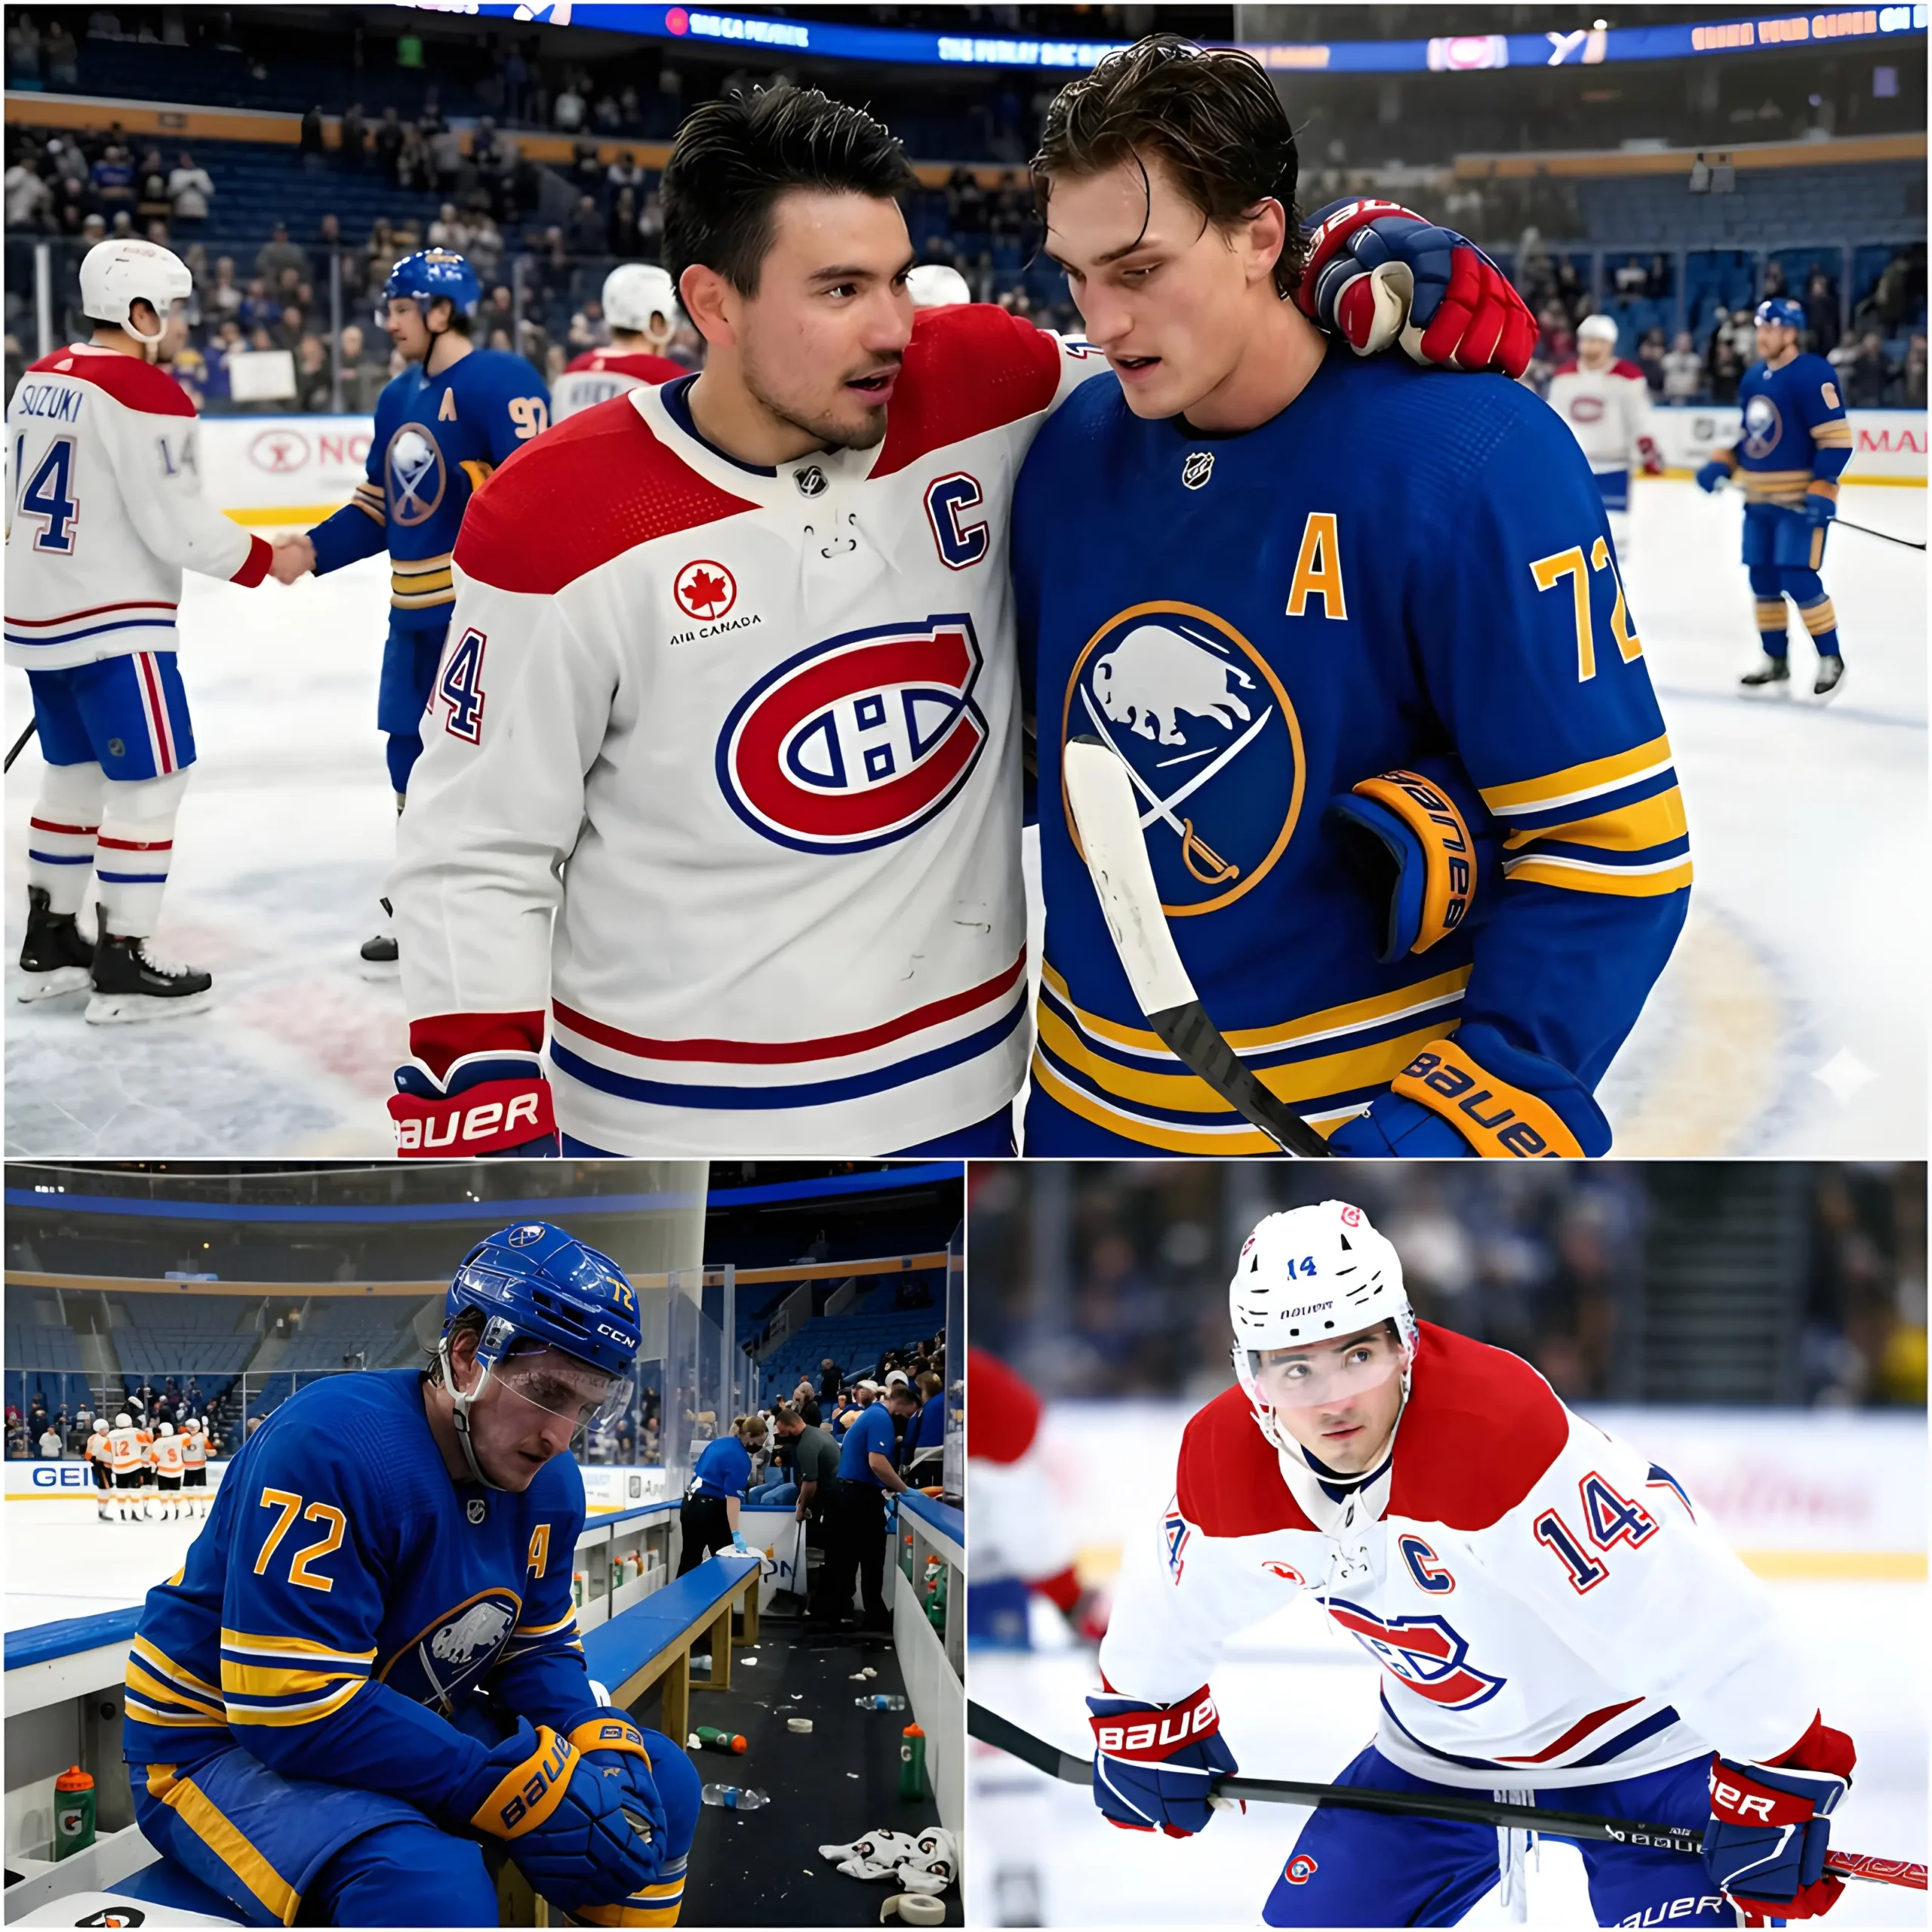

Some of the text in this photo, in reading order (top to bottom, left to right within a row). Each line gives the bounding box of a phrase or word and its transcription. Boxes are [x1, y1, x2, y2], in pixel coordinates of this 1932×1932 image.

[19, 384, 83, 423] SUZUKI
[438, 387, 457, 421] A
[923, 471, 990, 571] C
[1285, 512, 1349, 620] A
[699, 614, 761, 638] CANADA
[1529, 535, 1644, 682] 72
[1401, 1052, 1561, 1158] BAUE
[254, 1487, 347, 1592] 72
[528, 1524, 551, 1579] A
[1398, 1534, 1456, 1595] C
[1534, 1471, 1660, 1595] 14
[1613, 1896, 1723, 1928] AUER
